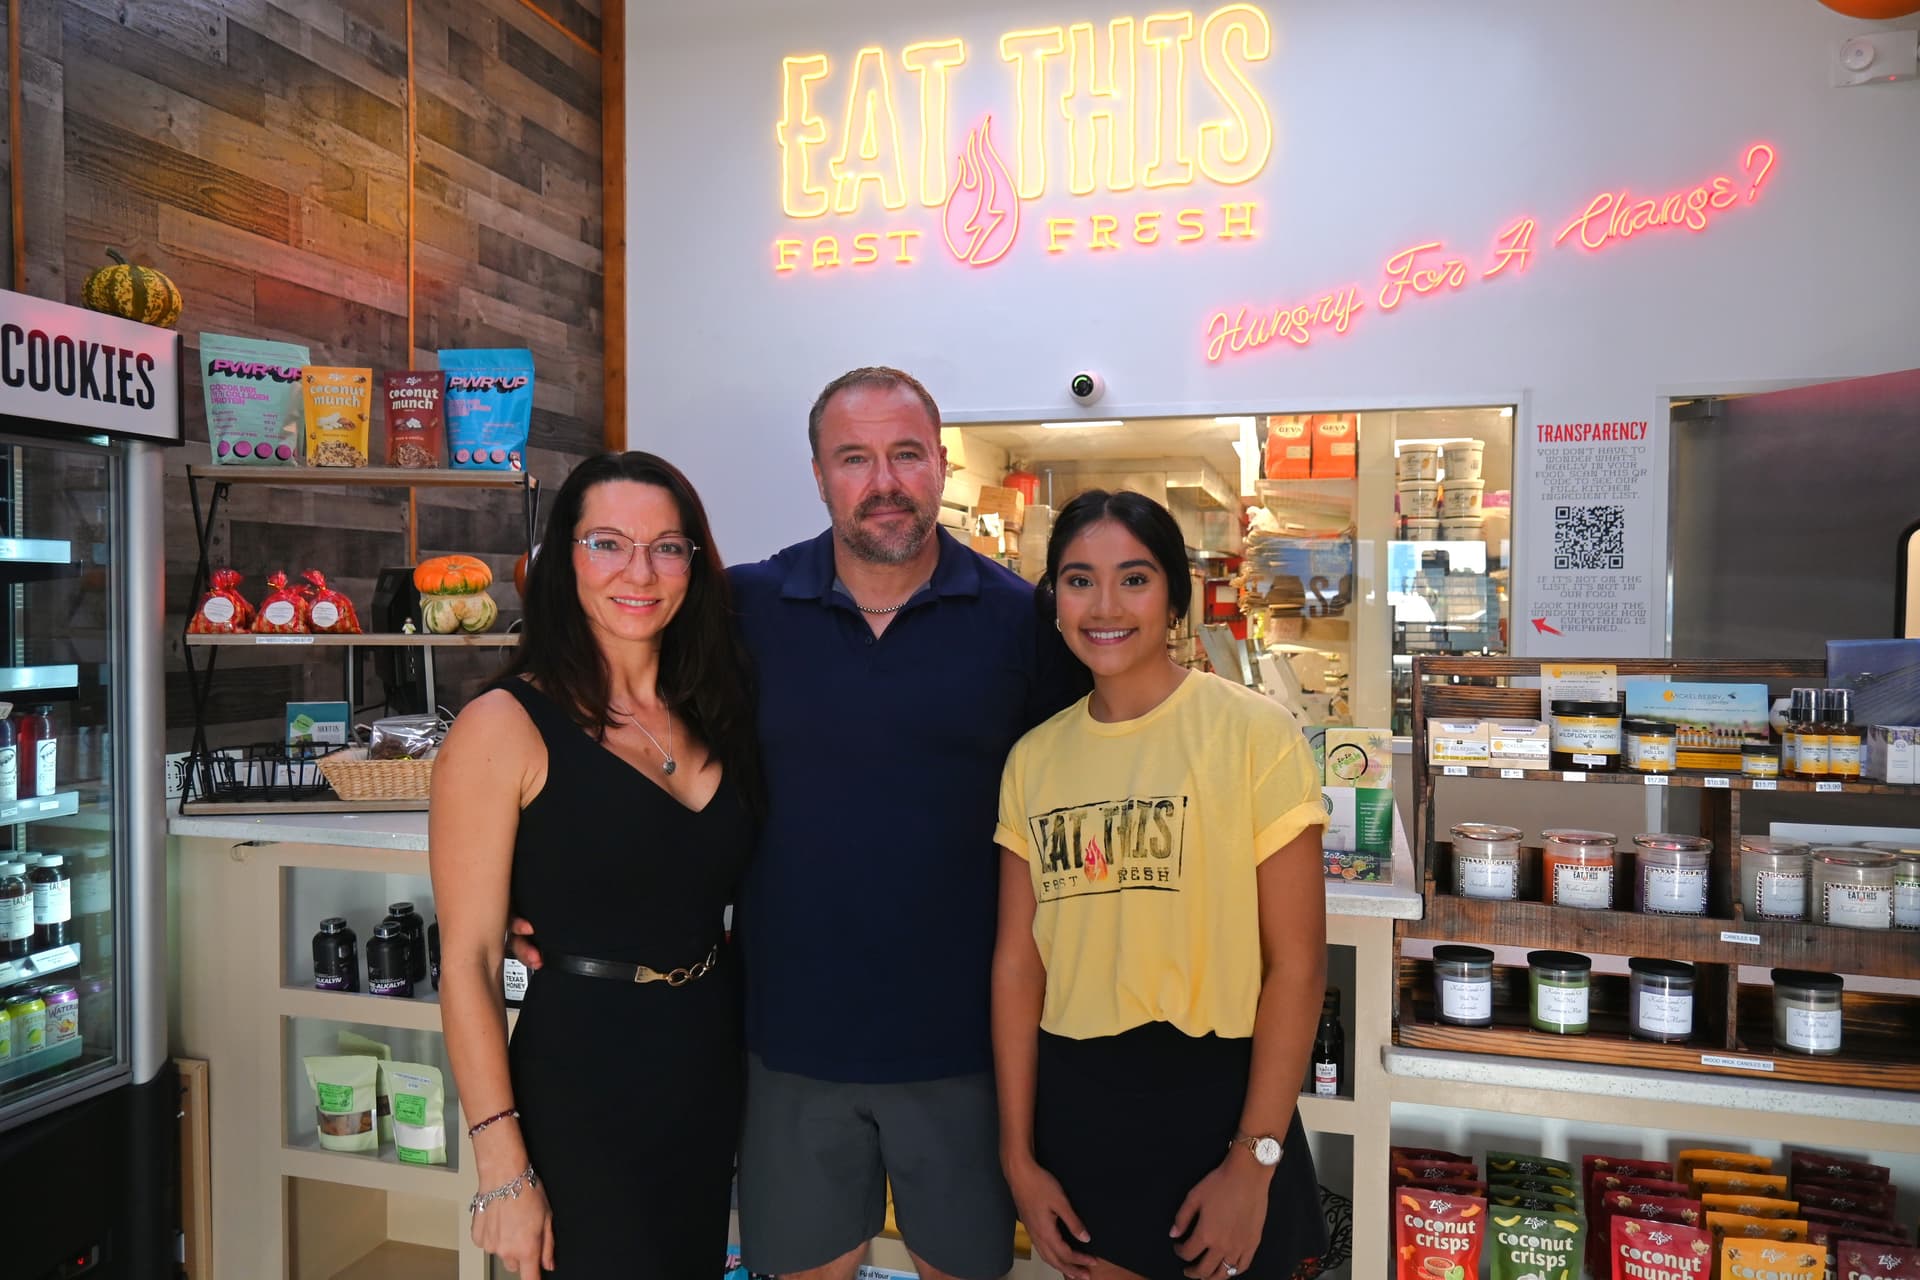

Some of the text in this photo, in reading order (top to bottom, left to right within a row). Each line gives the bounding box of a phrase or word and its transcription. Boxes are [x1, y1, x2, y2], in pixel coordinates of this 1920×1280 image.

[777, 3, 1272, 218] EAT THIS
[775, 202, 1259, 272] FAST FRESH
[1207, 288, 1364, 362] Hungry
[1378, 242, 1467, 310] For
[1482, 219, 1534, 278] A
[1, 323, 156, 410] COOKIES
[310, 384, 365, 396] coconut
[389, 388, 440, 400] coconut
[314, 396, 361, 408] munch
[392, 399, 434, 410] munch
[1537, 421, 1647, 443] TRANSPARENCY
[1537, 448, 1559, 456] YOU
[1598, 447, 1627, 455] HAVE
[1631, 446, 1646, 454] TO
[1592, 462, 1603, 470] IN
[1542, 492, 1608, 500] INGREDIENT
[1560, 590, 1582, 598] OUR
[1038, 799, 1175, 874] EAT THIS
[1404, 1214, 1476, 1235] coconut
[1416, 1232, 1471, 1254] crisps
[1498, 1231, 1573, 1252] coconut
[1511, 1248, 1567, 1271] crisps
[1620, 1244, 1702, 1273] coconut
[1625, 1261, 1695, 1280] munch
